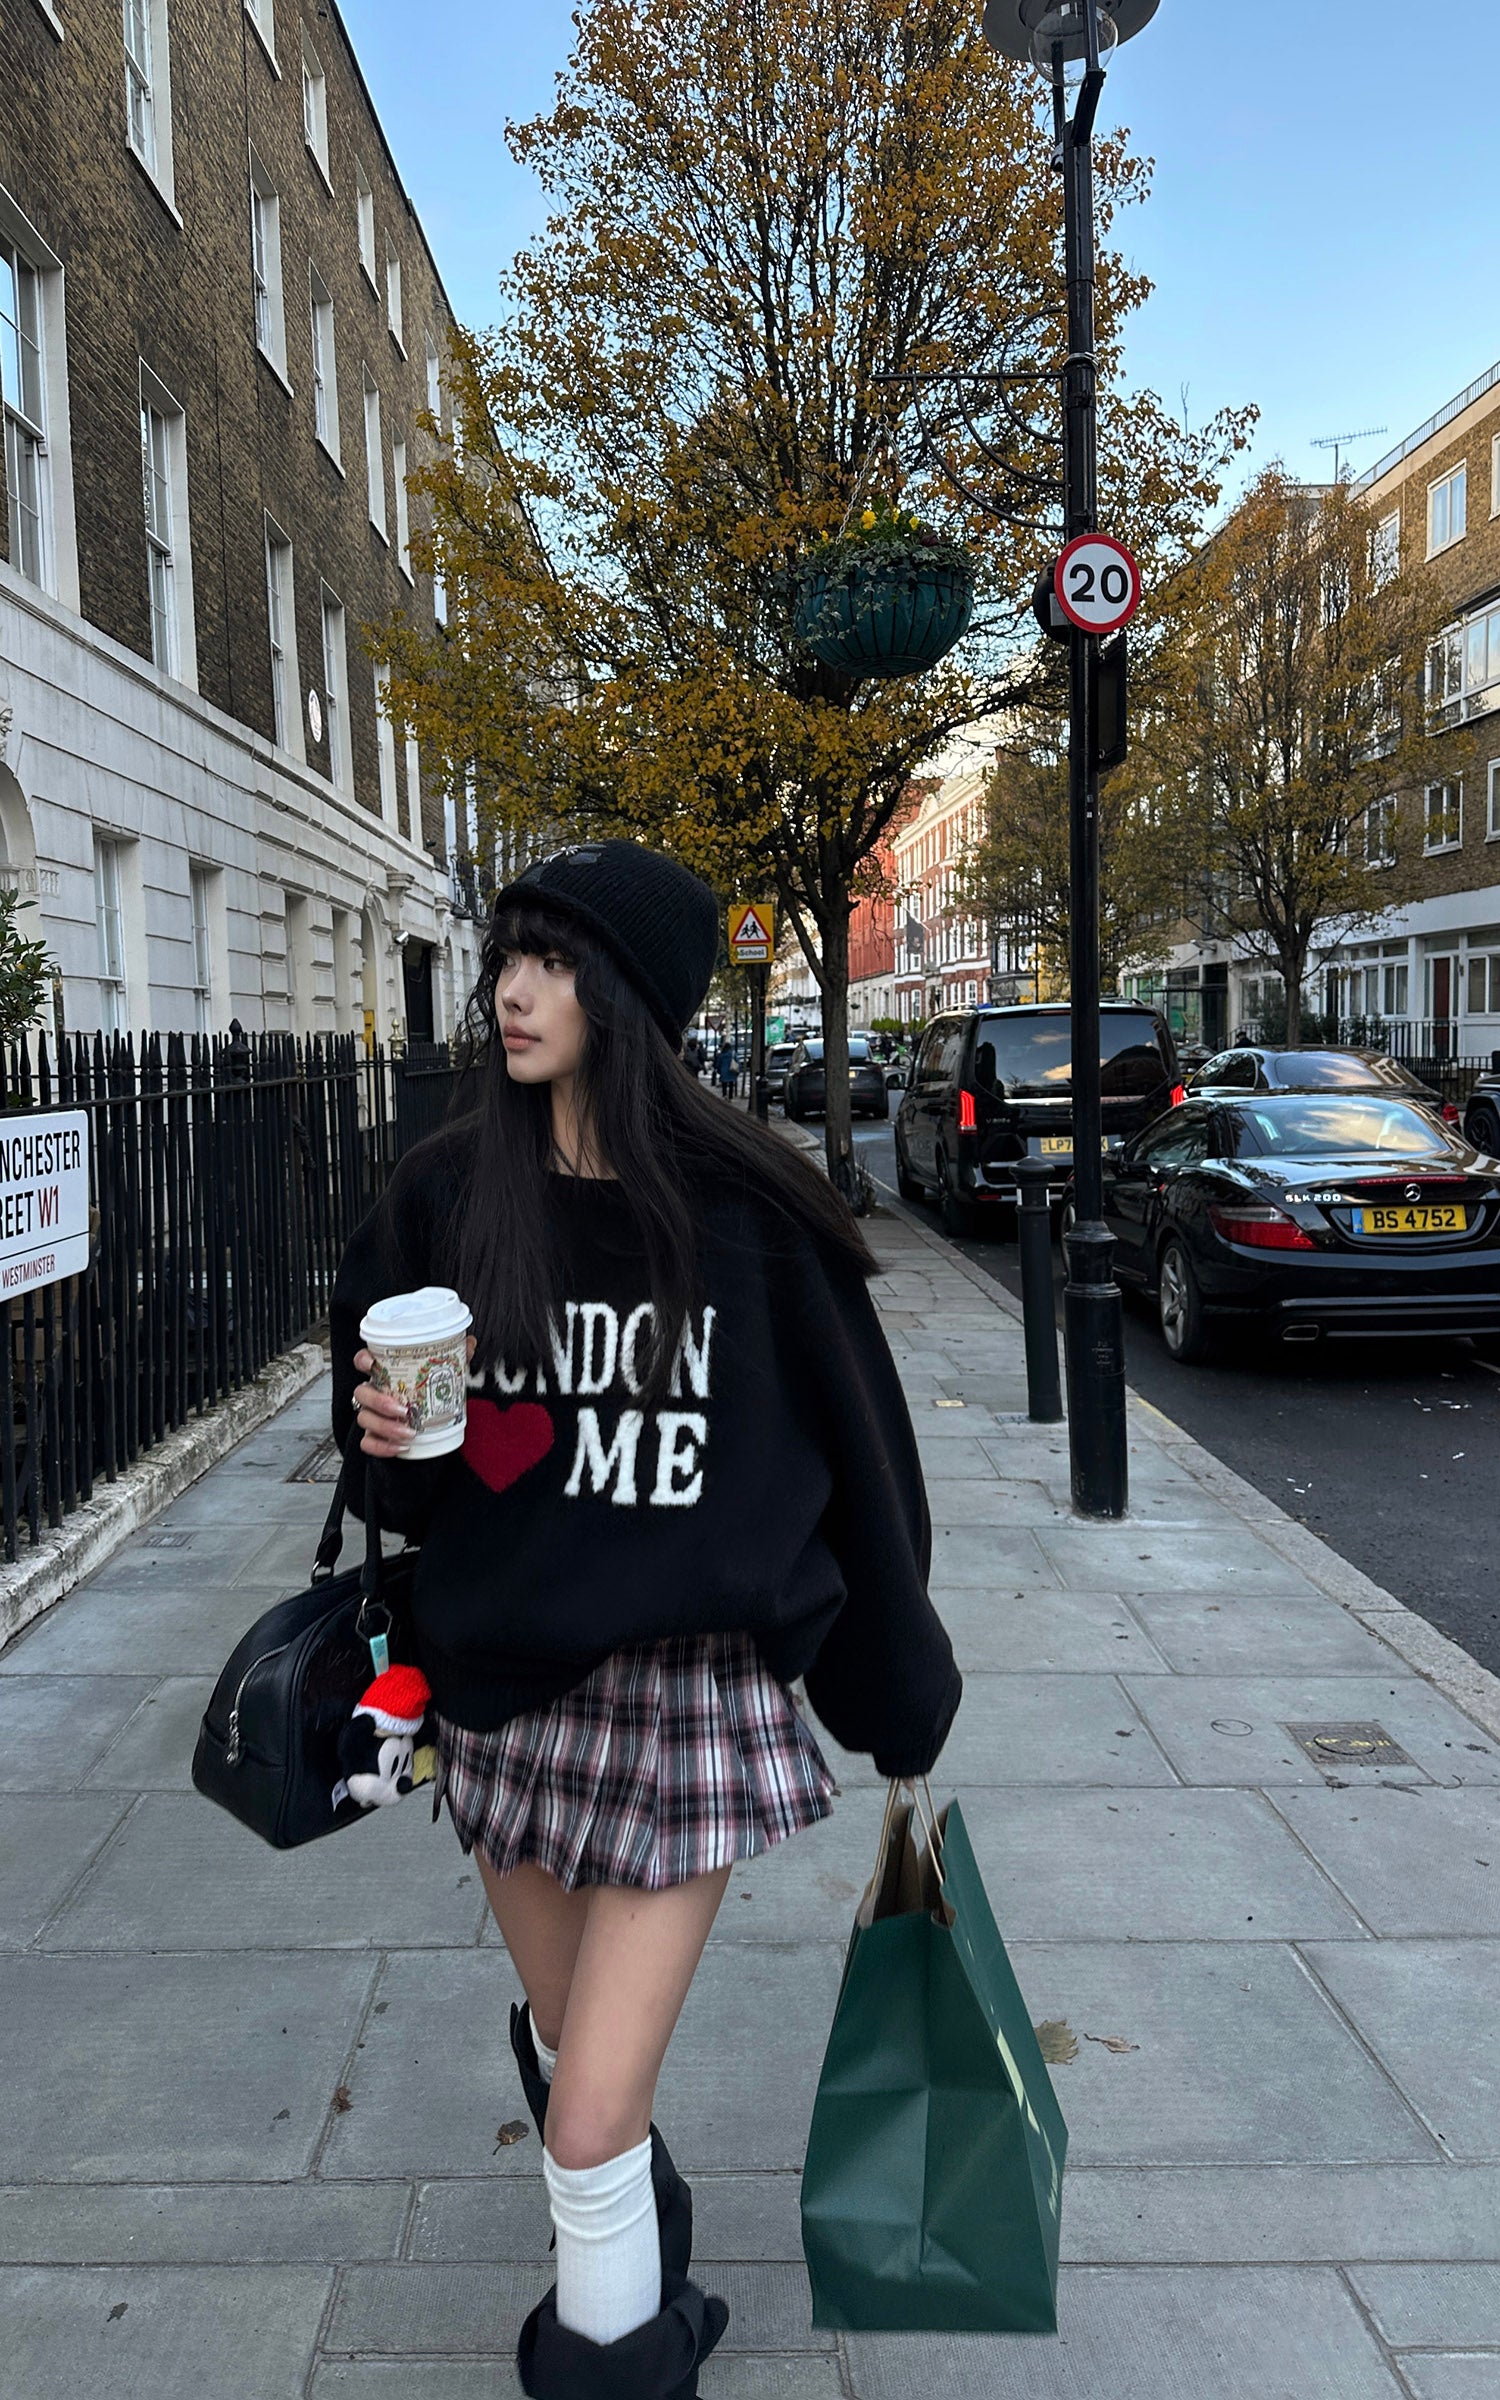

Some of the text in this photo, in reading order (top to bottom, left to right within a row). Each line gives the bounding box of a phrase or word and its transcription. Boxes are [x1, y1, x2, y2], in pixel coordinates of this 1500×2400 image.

[1069, 563, 1129, 604] 20
[739, 948, 765, 956] School
[38, 1185, 59, 1228] W1
[1285, 1193, 1342, 1202] SLK 200
[1373, 1208, 1457, 1229] BS 4752
[2, 1253, 56, 1289] WESTMINSTER
[563, 1406, 707, 1507] ME
